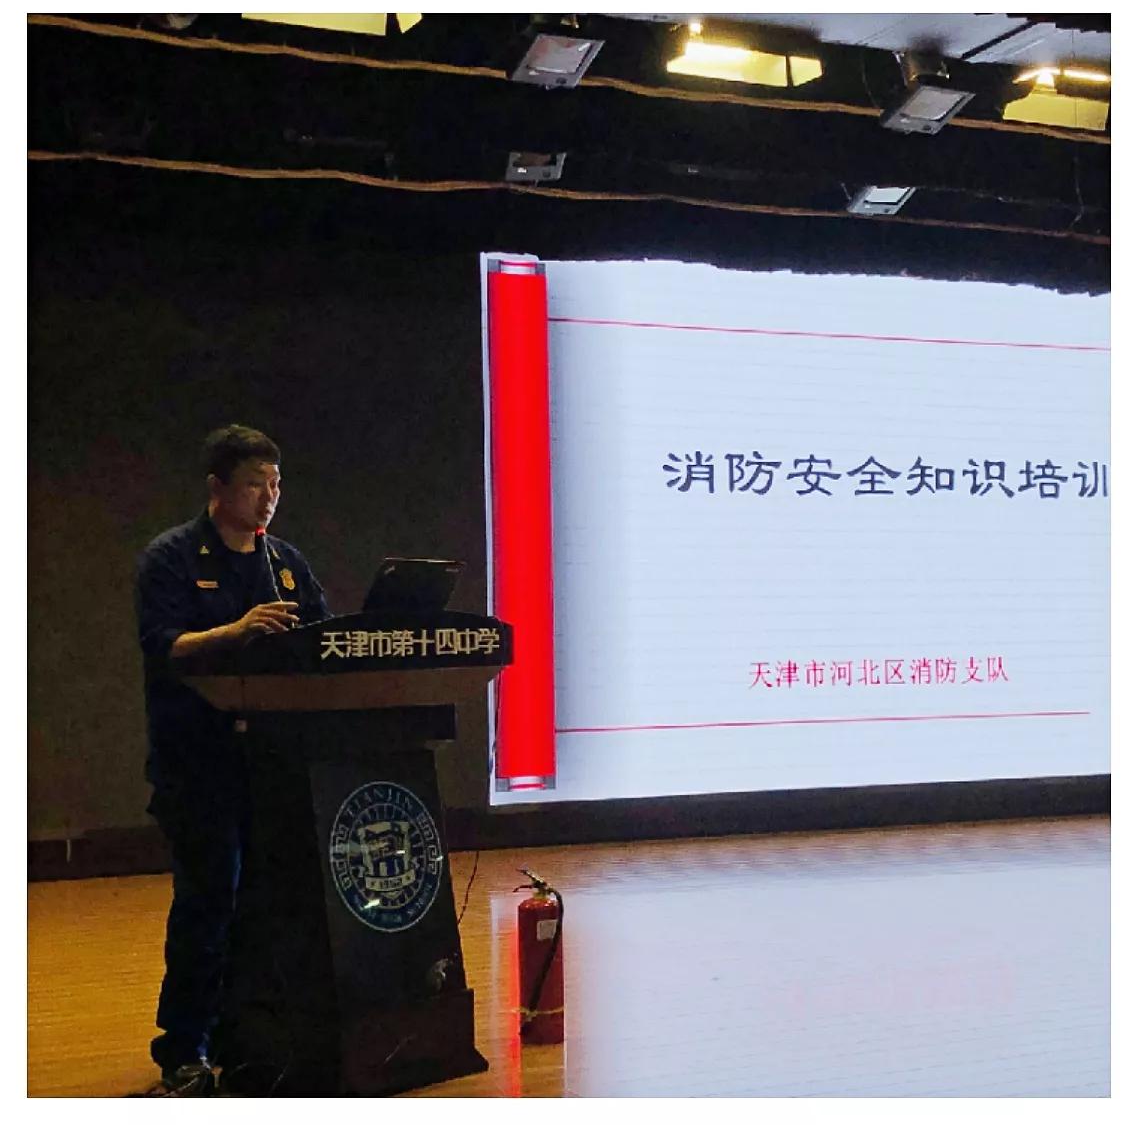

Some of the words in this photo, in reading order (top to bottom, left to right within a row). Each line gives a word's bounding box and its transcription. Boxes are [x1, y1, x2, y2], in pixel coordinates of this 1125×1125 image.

[662, 451, 1109, 499] 消防安全知识培训
[321, 628, 500, 659] 天津市第十四中学
[748, 657, 1009, 689] 天津市河北区消防支队
